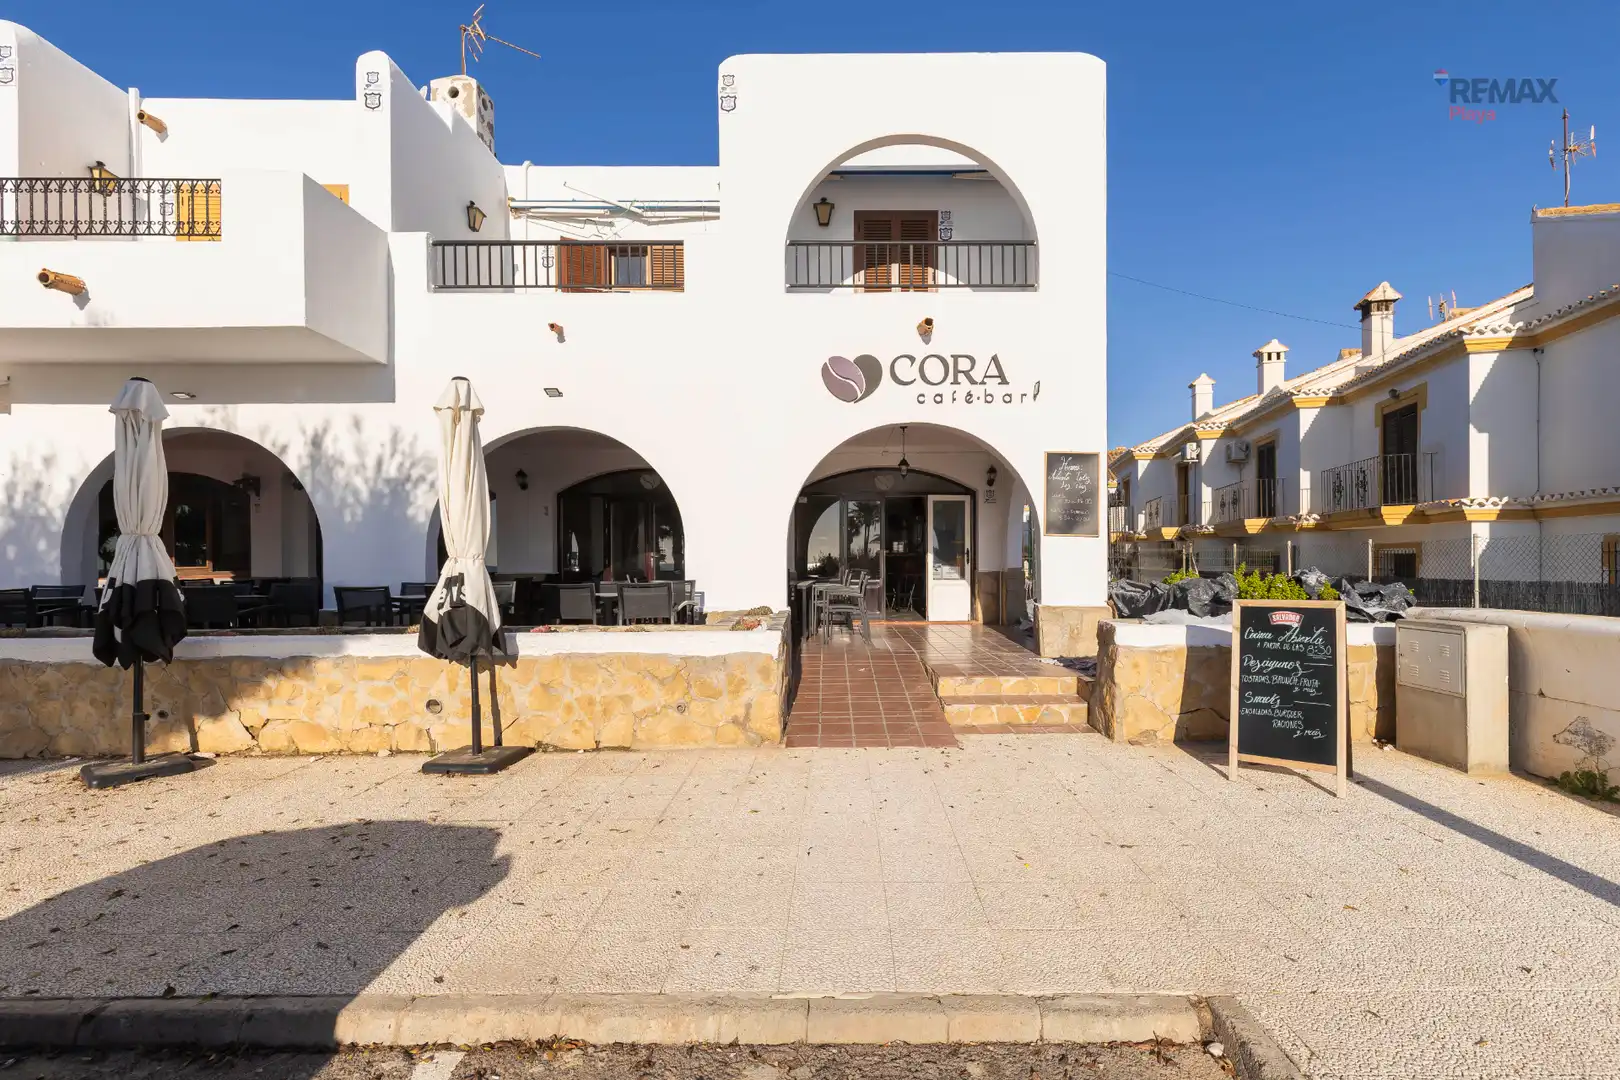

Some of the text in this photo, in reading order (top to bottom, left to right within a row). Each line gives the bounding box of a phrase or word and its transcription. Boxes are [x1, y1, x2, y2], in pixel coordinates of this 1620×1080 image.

[889, 353, 1009, 386] CORA
[1244, 625, 1328, 645] Cocina Abierta
[1283, 643, 1291, 651] DE
[1292, 644, 1305, 653] LAS
[1306, 645, 1332, 656] 8:30
[1241, 654, 1309, 677] Desayunos
[1243, 691, 1285, 709] Snacks
[1271, 719, 1304, 730] RACIONES
